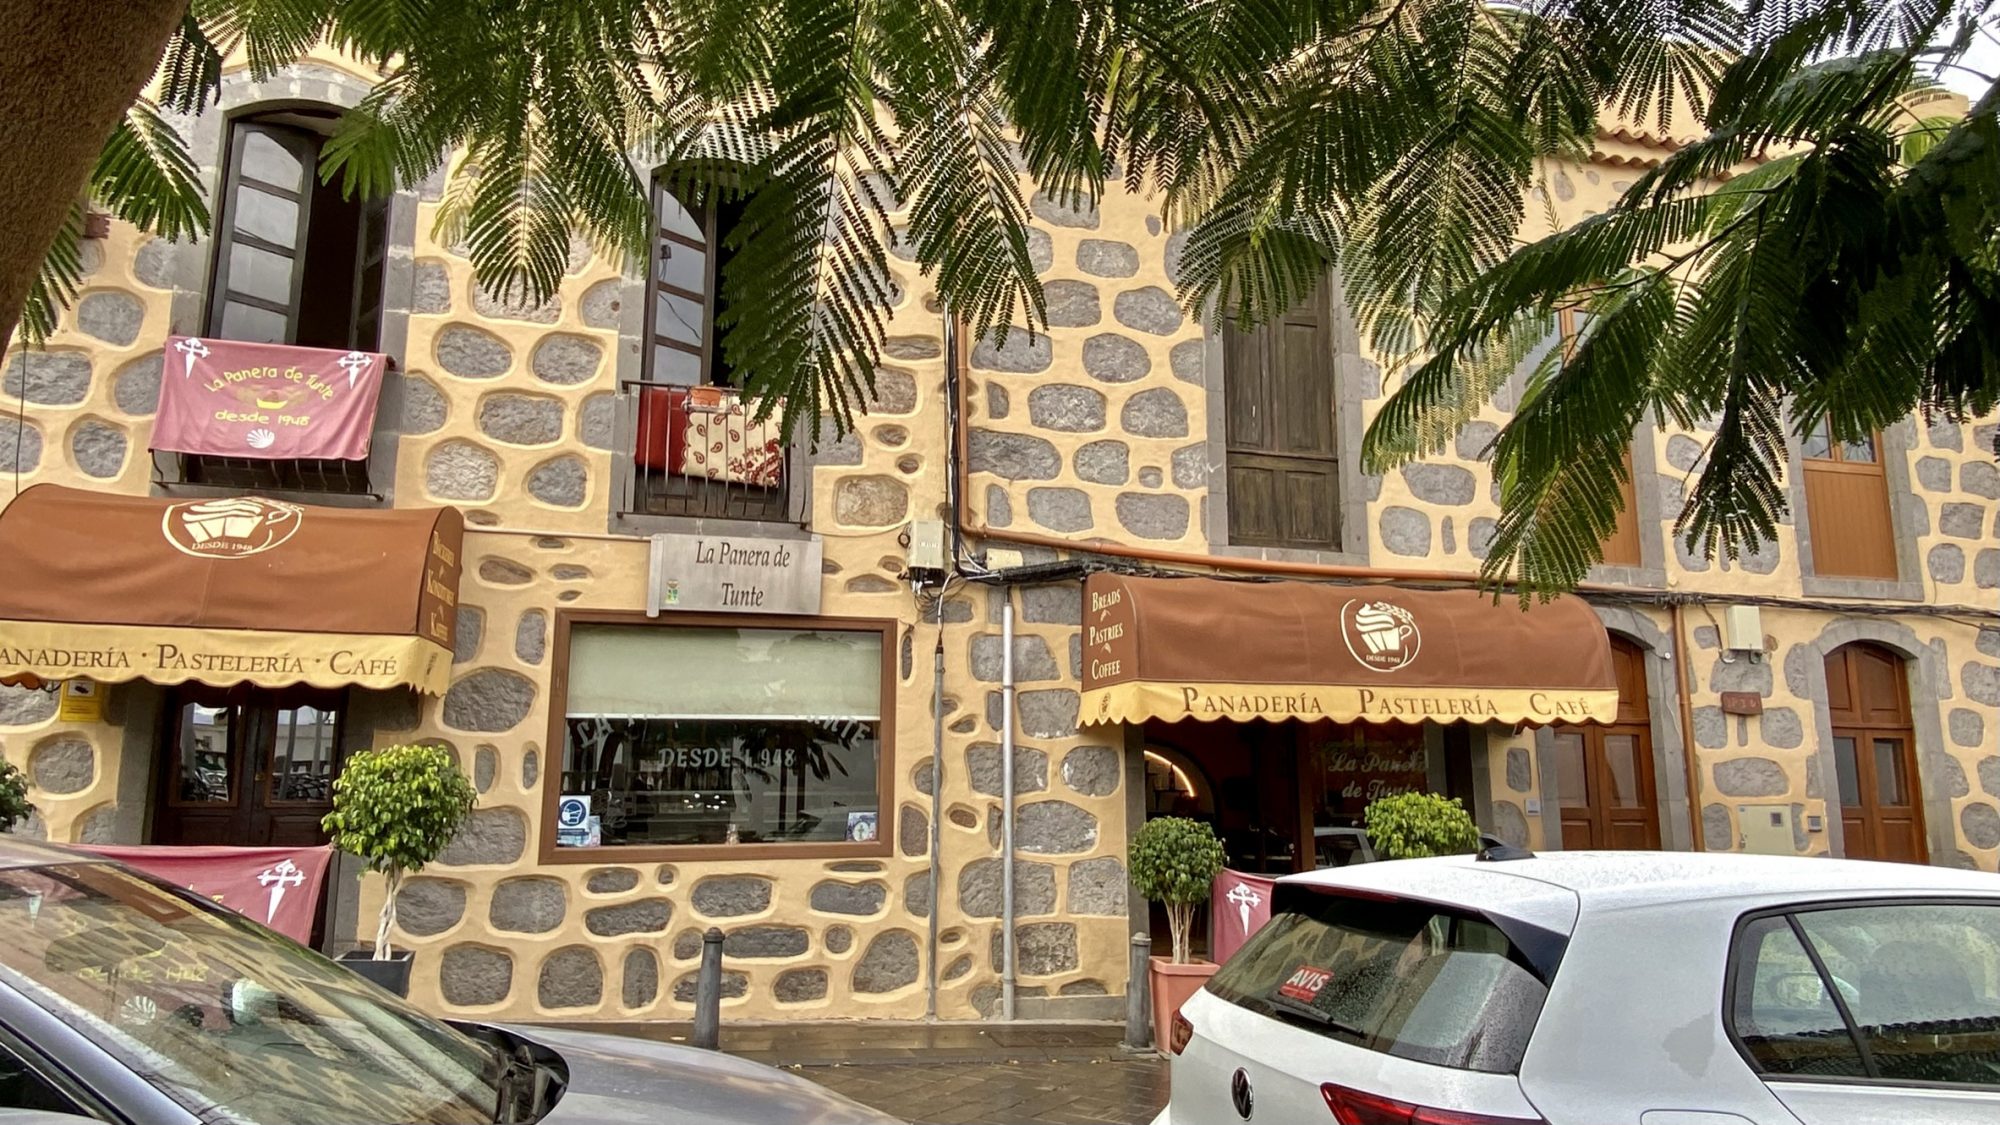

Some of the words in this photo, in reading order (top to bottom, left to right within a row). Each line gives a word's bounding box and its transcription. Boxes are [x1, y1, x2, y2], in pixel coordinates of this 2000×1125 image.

[204, 379, 225, 393] La
[224, 367, 278, 384] Panera
[284, 366, 304, 383] de
[306, 374, 334, 401] Tunte
[215, 410, 270, 425] desde
[278, 415, 311, 426] 1948
[191, 540, 229, 551] DESDE
[695, 540, 715, 565] La
[718, 541, 771, 567] Panera
[773, 544, 791, 568] de
[721, 582, 764, 607] Tunte
[1092, 589, 1121, 612] BREADS
[1089, 622, 1124, 646] PASTRIES
[0, 647, 131, 669] ANADERÍA
[156, 643, 305, 674] PASTELERÍA
[329, 650, 397, 676] CAFÉ
[1092, 658, 1121, 680] COFFEE
[1181, 686, 1323, 714] PANADERÍA
[1357, 688, 1499, 715] PASTELERÍA
[1529, 692, 1593, 716] CAFÉ
[658, 747, 732, 768] DESDE
[1286, 968, 1330, 991] AVIS
